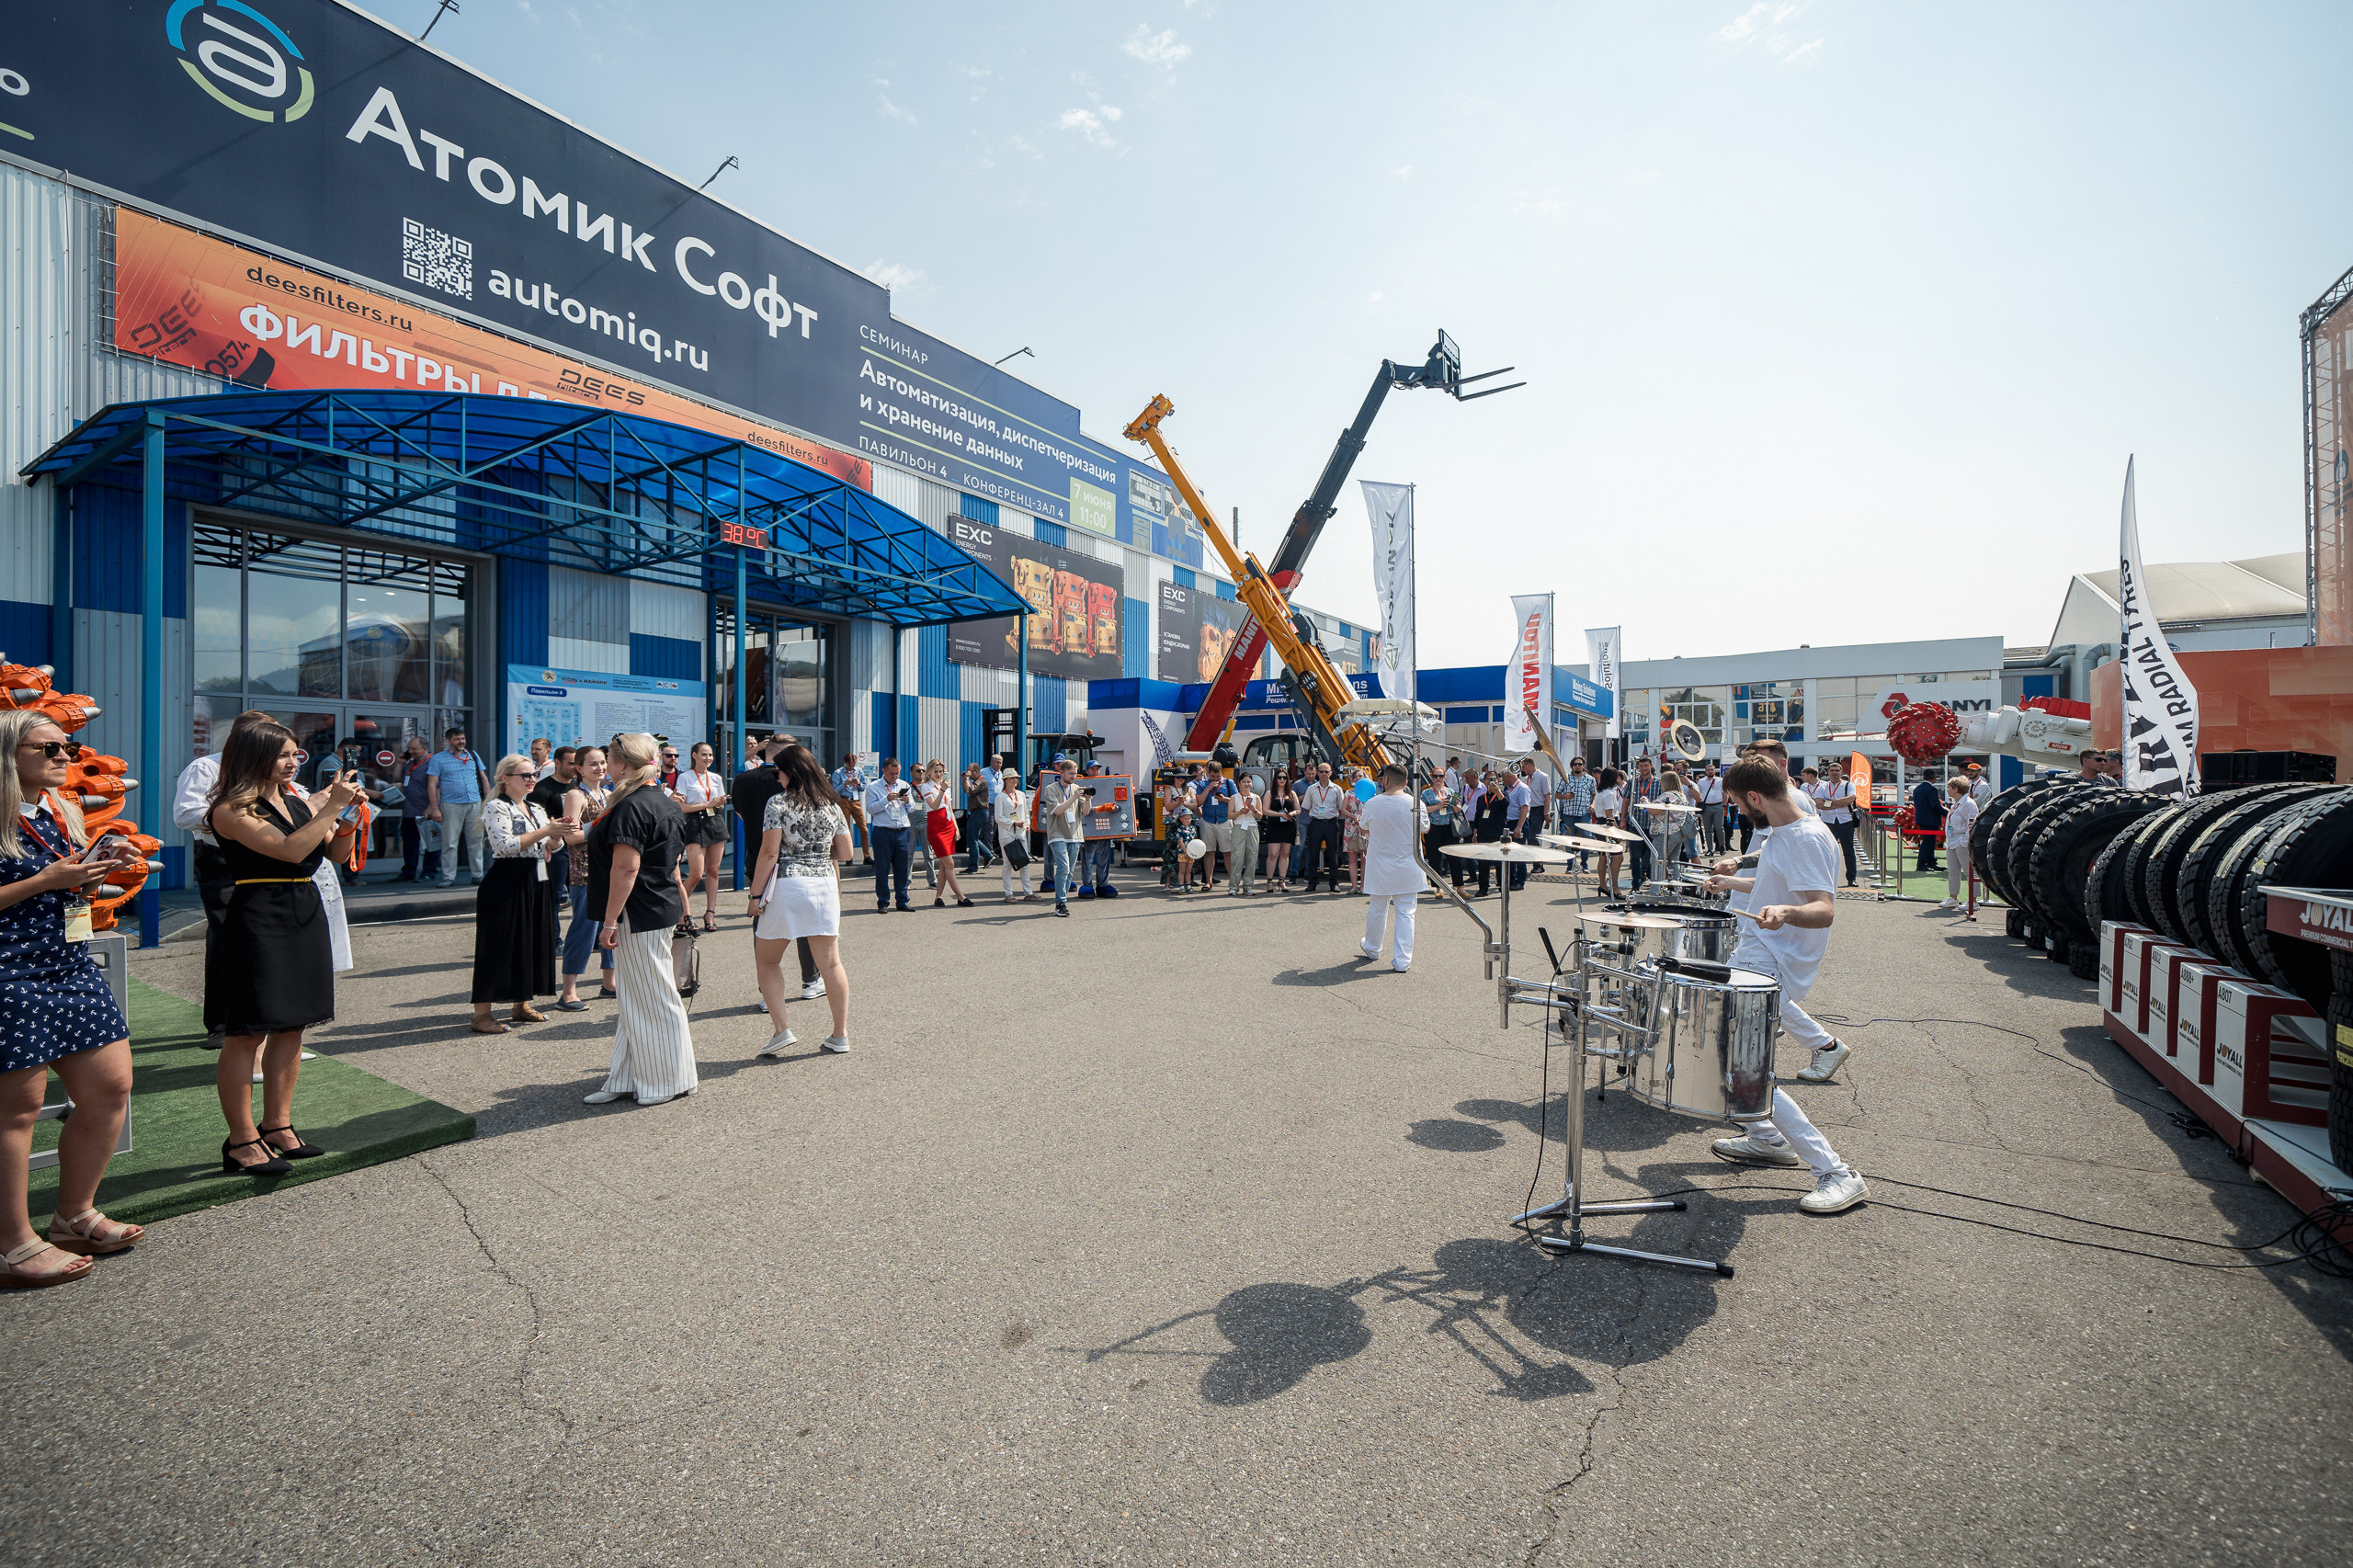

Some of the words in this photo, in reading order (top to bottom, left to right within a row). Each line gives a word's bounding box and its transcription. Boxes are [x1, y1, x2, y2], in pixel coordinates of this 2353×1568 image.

[346, 86, 657, 273] Атомик
[675, 236, 818, 338] Софт
[246, 266, 413, 332] deesfilters.ru
[488, 269, 709, 372] automiq.ru
[240, 303, 480, 393] ФИЛЬТРЫ
[859, 324, 928, 365] СЕМИНАР
[560, 369, 645, 405] DEES
[859, 359, 1000, 438] Автоматизация,
[1002, 425, 1116, 484] диспетчеризация
[859, 395, 872, 411] и
[878, 403, 963, 446] хранение
[966, 436, 1024, 471] данных
[747, 432, 828, 465] deesfilters.ru
[859, 436, 936, 474] ПАВИЛЬОН
[939, 464, 948, 478] 4
[963, 472, 1055, 516] КОНФЕРЕНЦ-ЗАЛ
[1057, 506, 1064, 518] 4
[1074, 483, 1080, 497] 7
[1083, 491, 1112, 512] июня
[956, 522, 992, 545] EXC
[1079, 506, 1107, 528] 11:00
[956, 540, 977, 550] ENERGY
[1163, 586, 1186, 602] EXC
[1233, 614, 1260, 661] MANIT
[2131, 636, 2192, 717] RADIAL
[2122, 979, 2139, 997] JOYALL
[2150, 995, 2166, 1016] JOYALL
[2178, 1017, 2200, 1041] JOYALL
[2216, 1042, 2243, 1070] JOYALL
